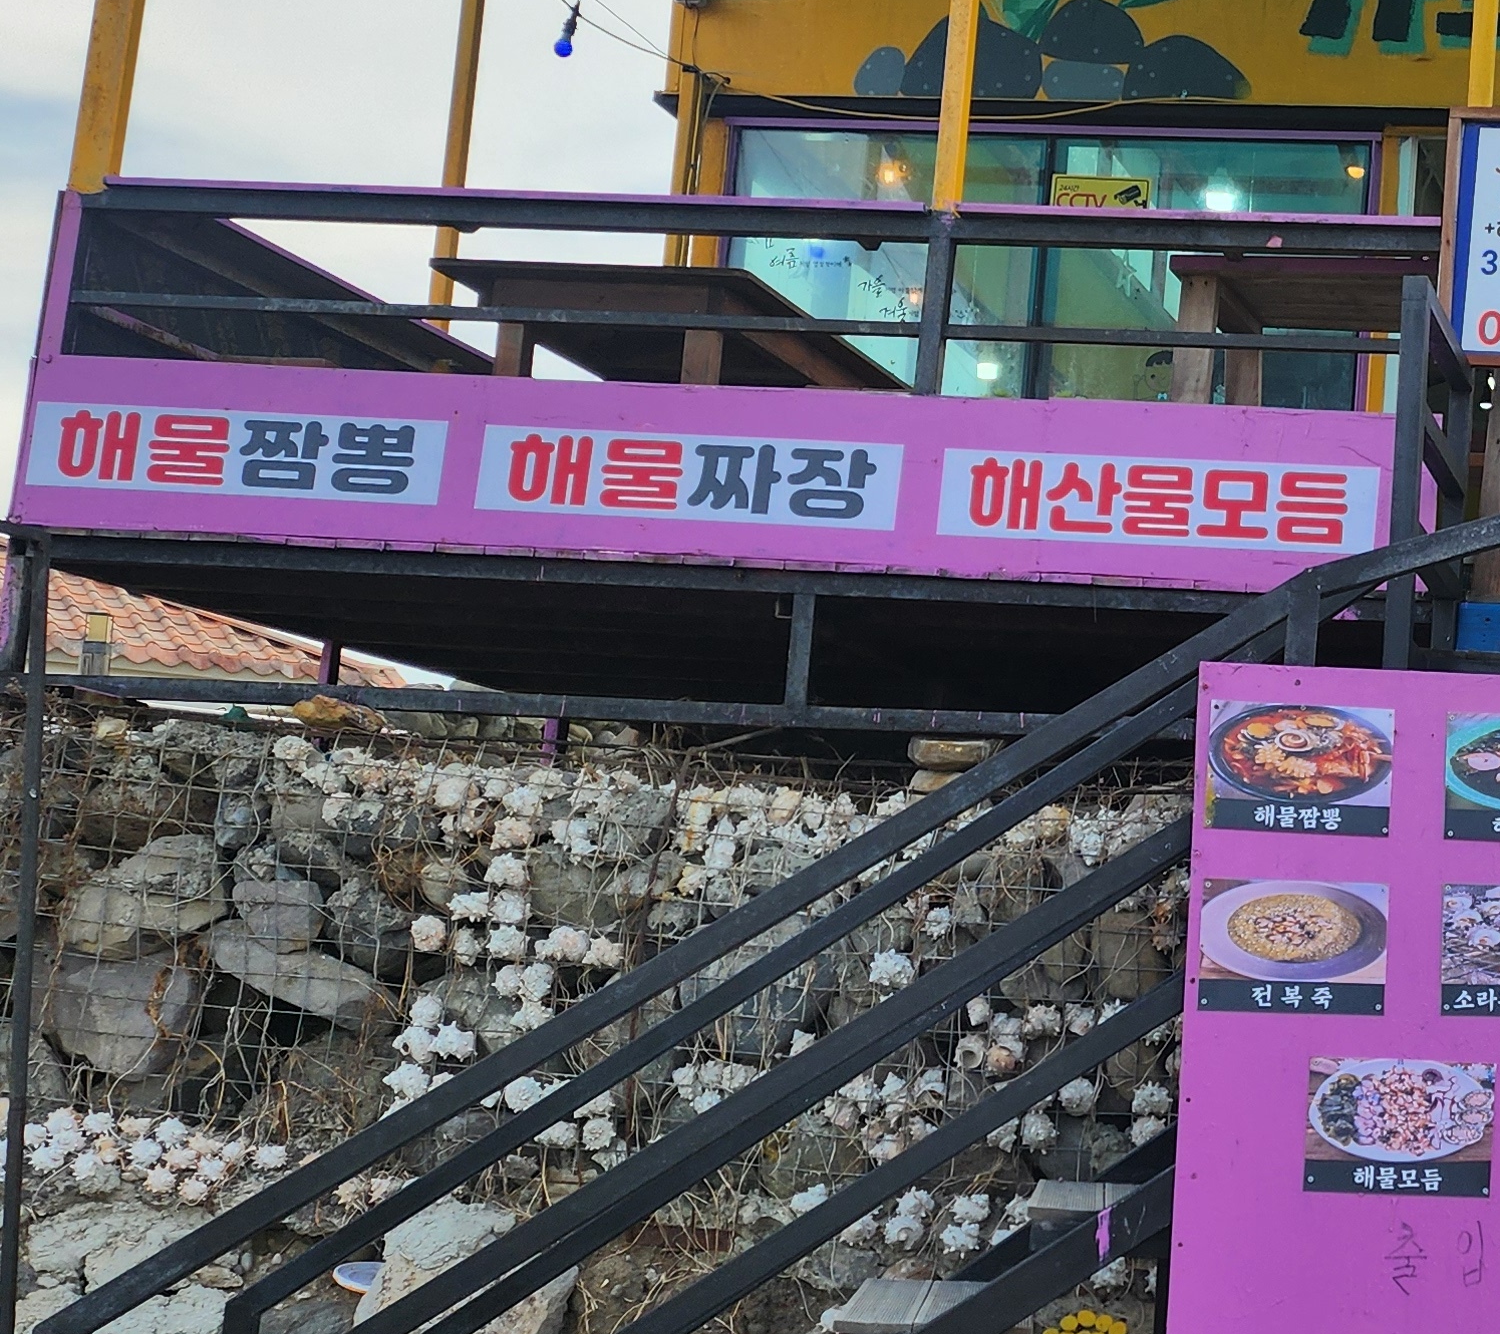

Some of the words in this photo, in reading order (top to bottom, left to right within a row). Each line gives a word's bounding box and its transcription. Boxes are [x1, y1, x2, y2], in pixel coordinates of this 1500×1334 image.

[1057, 193, 1107, 207] CCTV
[57, 410, 416, 495] 해물짬뽕
[508, 433, 877, 520] 해물짜장
[969, 457, 1349, 545] 해산물모듬
[1253, 804, 1342, 833] 해물짬뽕
[1353, 1167, 1443, 1192] 해물모듬
